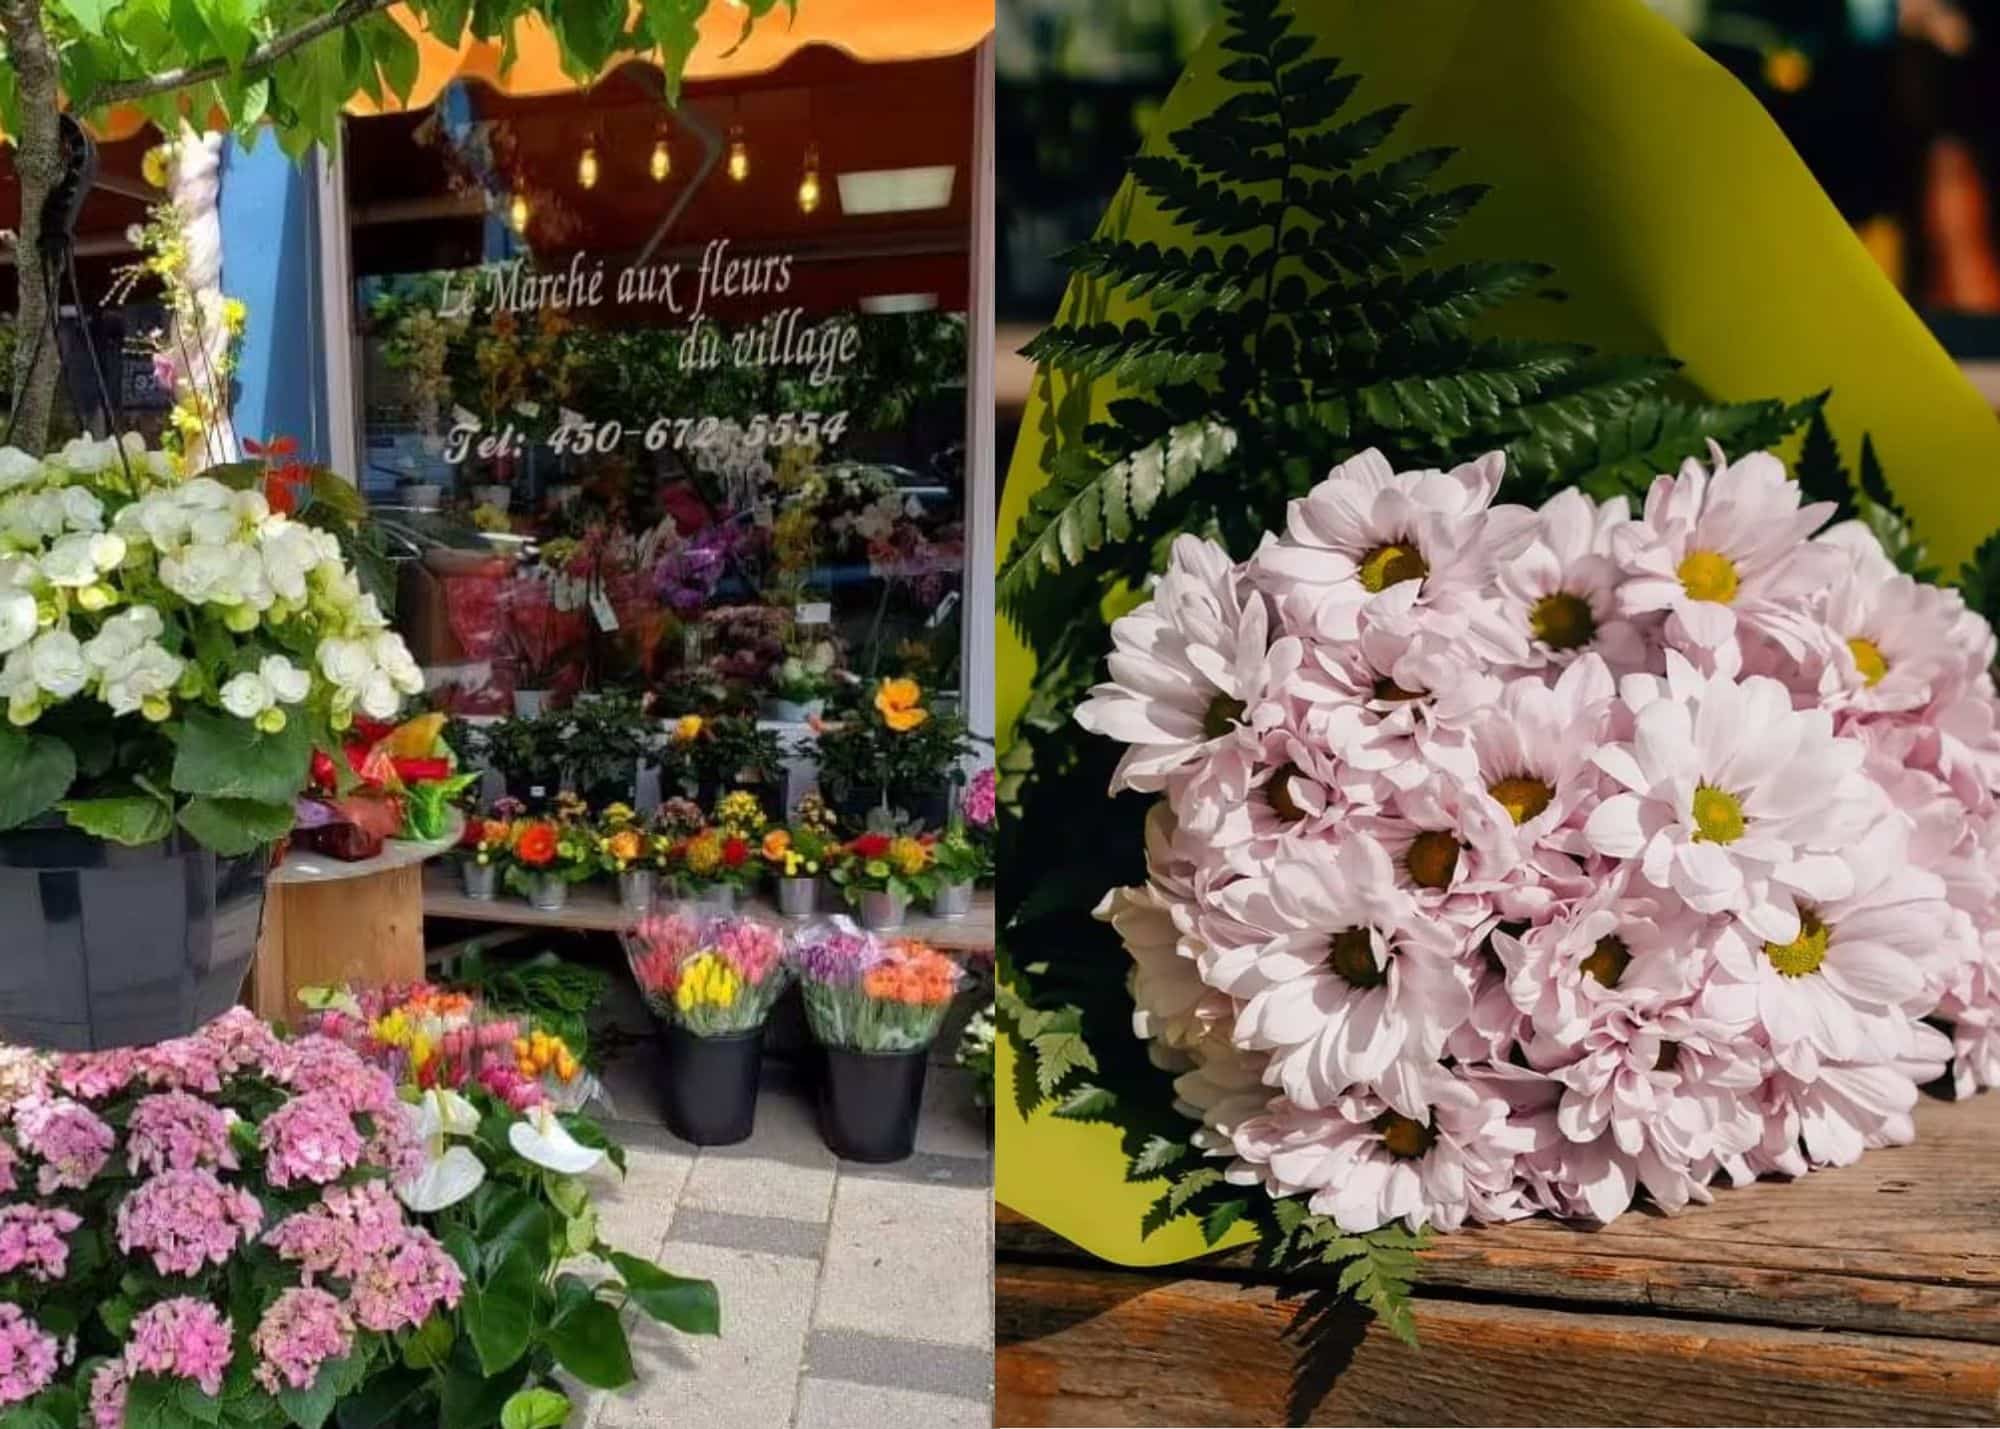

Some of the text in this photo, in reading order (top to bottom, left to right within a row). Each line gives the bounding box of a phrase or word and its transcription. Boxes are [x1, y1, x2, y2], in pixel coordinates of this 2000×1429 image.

[437, 239, 793, 322] Le Marché aux fleurs
[678, 307, 857, 387] du village
